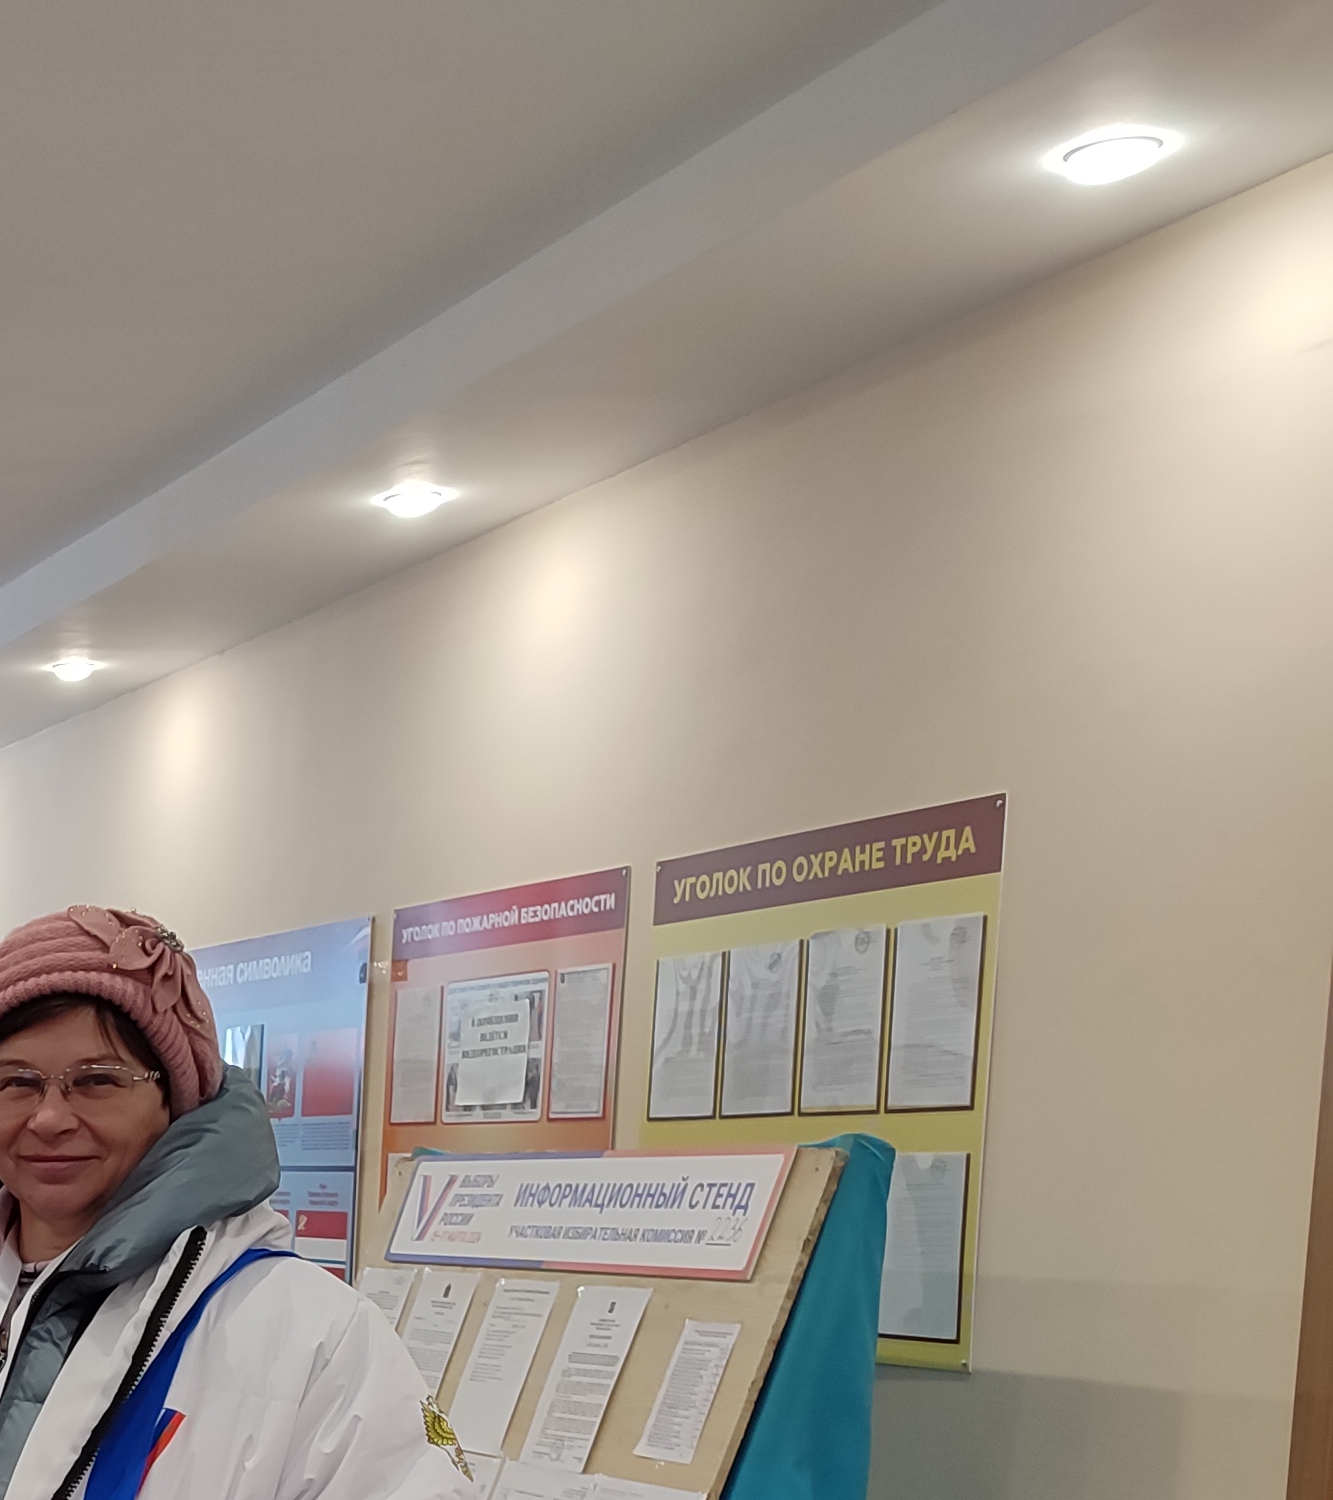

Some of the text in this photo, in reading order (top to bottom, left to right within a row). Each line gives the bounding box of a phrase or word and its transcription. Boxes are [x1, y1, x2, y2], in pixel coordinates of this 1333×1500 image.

[673, 825, 977, 904] УГОЛОК ПО ОХРАНЕ ТРУДА
[401, 892, 616, 944] УГОЛОК ПО ПОЖАРНОЙ БЕЗОПАСНОСТИ
[236, 951, 312, 984] символика
[512, 1176, 755, 1217] ИНФОРМАЦИОННЫЙ СТЕНД
[438, 1212, 475, 1226] РОССИИ
[508, 1224, 562, 1240] УЧАСТКОВАЯ
[563, 1226, 639, 1242] ИЗБИРАТЕЛЬНАЯ
[640, 1228, 695, 1243] КОМИССИЯ
